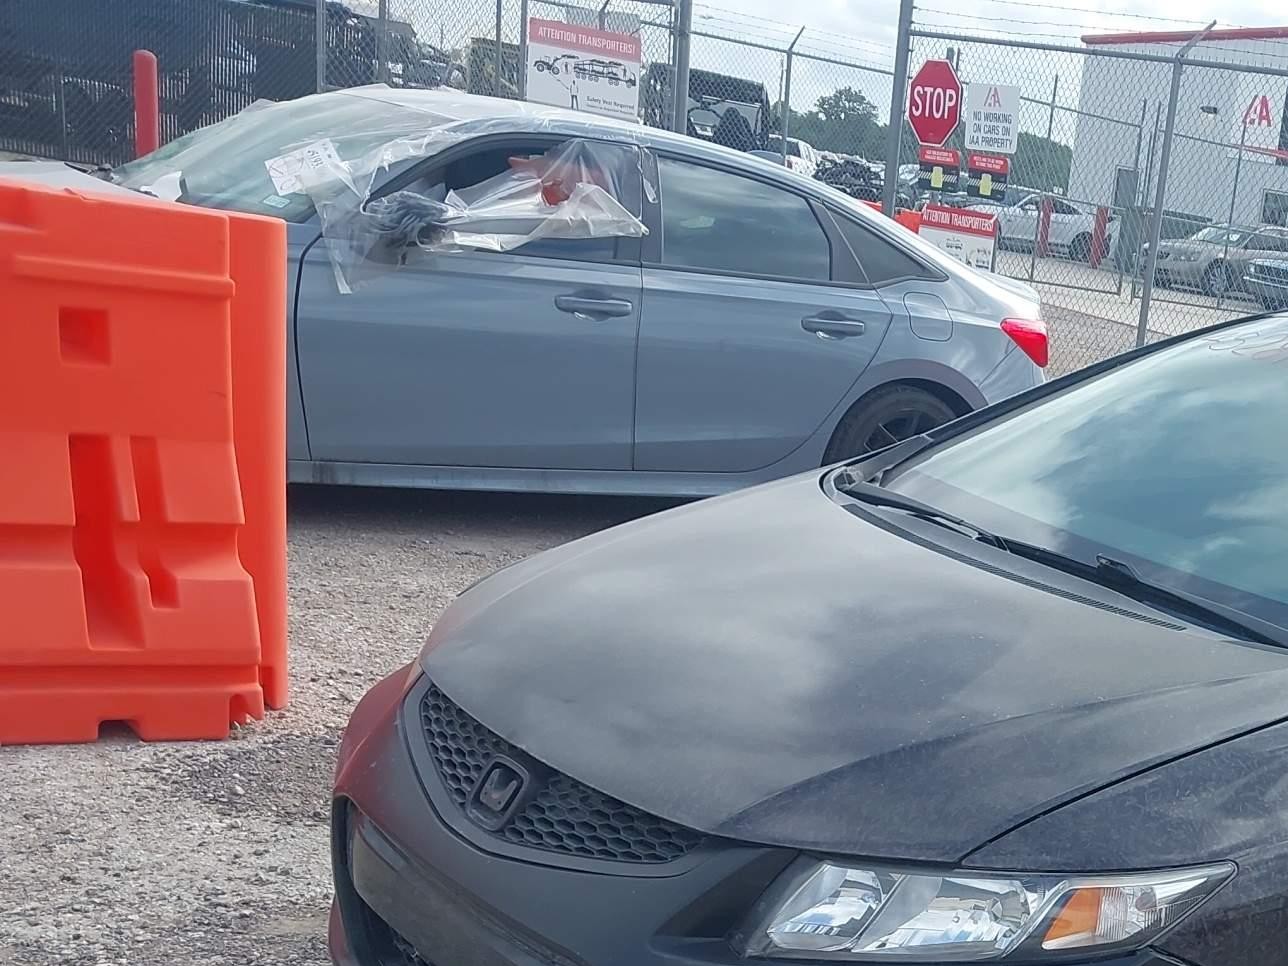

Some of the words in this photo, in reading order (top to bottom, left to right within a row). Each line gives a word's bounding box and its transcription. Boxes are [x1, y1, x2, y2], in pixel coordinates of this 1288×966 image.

[538, 26, 576, 43] ATTENTION
[578, 34, 636, 56] TRANSPORTERS!
[912, 86, 956, 119] STOP
[973, 111, 982, 121] NO
[983, 111, 1012, 124] WORKING
[973, 122, 982, 133] ON
[983, 123, 1000, 136] CARS
[1001, 126, 1011, 137] ON
[969, 135, 980, 146] IAA
[981, 137, 1013, 149] PROPERTY
[922, 209, 951, 225] ATTENTION
[952, 214, 994, 232] TRANSPORTERS!
